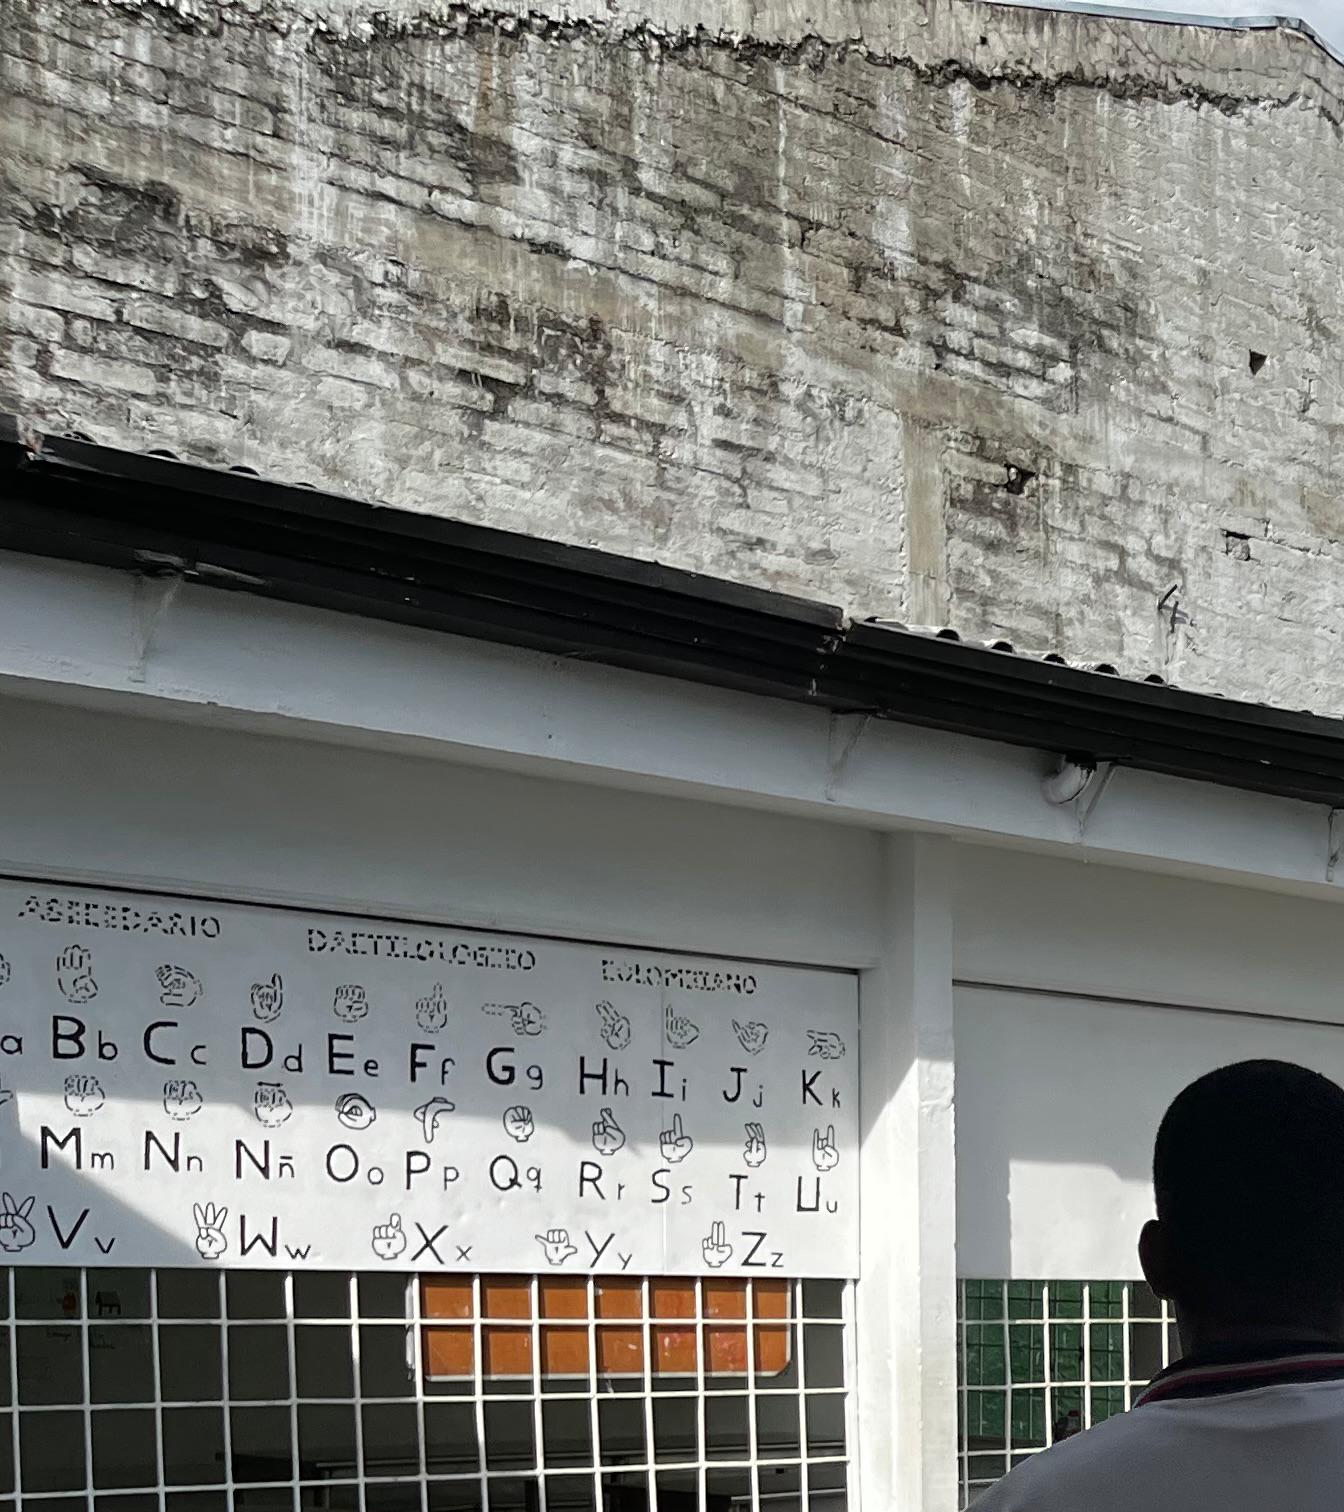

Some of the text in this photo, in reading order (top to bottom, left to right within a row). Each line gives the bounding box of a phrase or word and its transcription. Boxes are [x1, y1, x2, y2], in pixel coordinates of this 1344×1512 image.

[52, 1015, 118, 1061] Bb
[241, 1027, 303, 1073] Dd
[328, 1033, 379, 1077] Ee
[410, 1043, 456, 1086] Ff
[486, 1047, 543, 1090] Gg
[579, 1056, 629, 1096] Hh
[651, 1059, 687, 1101] Ii
[722, 1066, 763, 1108] Jj
[802, 1069, 840, 1108] Kk
[40, 1126, 114, 1170] Mm
[144, 1130, 202, 1172] Nn
[406, 1150, 459, 1191] Pp
[489, 1155, 542, 1193] Qq
[579, 1161, 625, 1200] Rr
[651, 1168, 692, 1204] Ss
[729, 1174, 765, 1212] Tt
[797, 1176, 837, 1213] Uu
[47, 1205, 116, 1254] Vv
[240, 1214, 311, 1260] Ww
[585, 1231, 632, 1270] Yy
[741, 1232, 783, 1267] Zz
